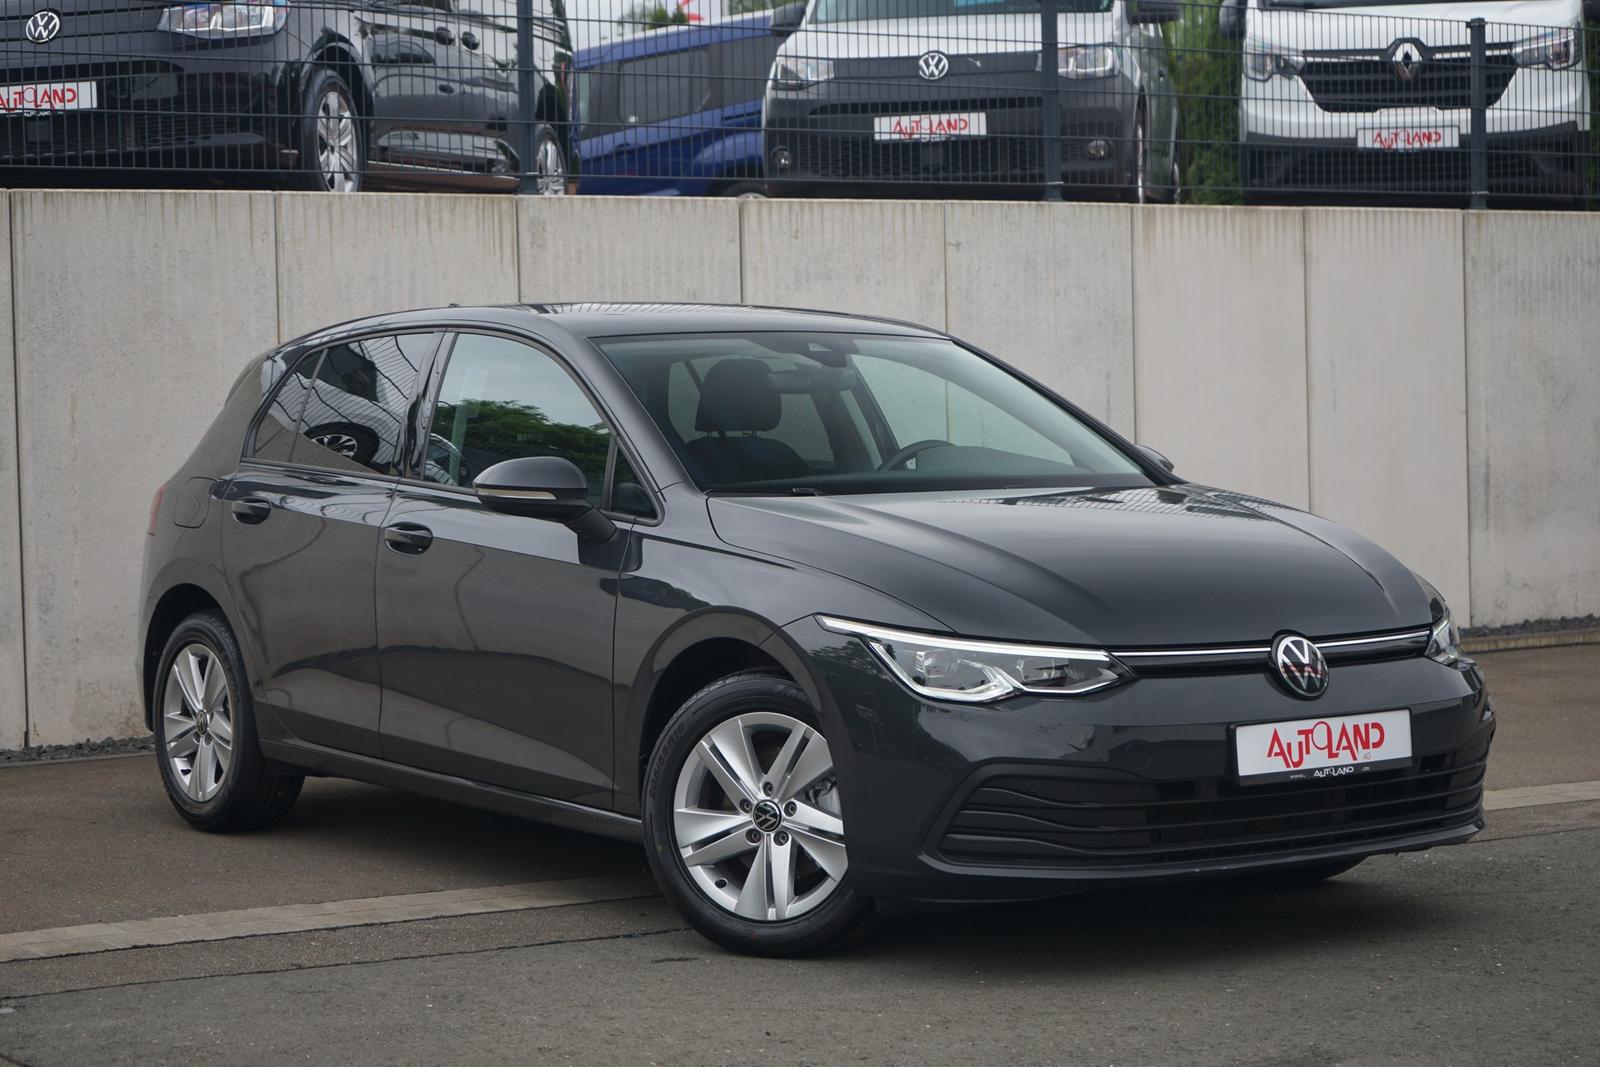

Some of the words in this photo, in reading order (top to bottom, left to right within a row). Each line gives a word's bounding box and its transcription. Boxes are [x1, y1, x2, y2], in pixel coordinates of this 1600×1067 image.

[892, 116, 969, 139] AUTOLAND
[1373, 128, 1442, 148] AUTOLAND
[1266, 720, 1385, 769] AUTOLAND
[1313, 766, 1355, 778] AUTOLAND
